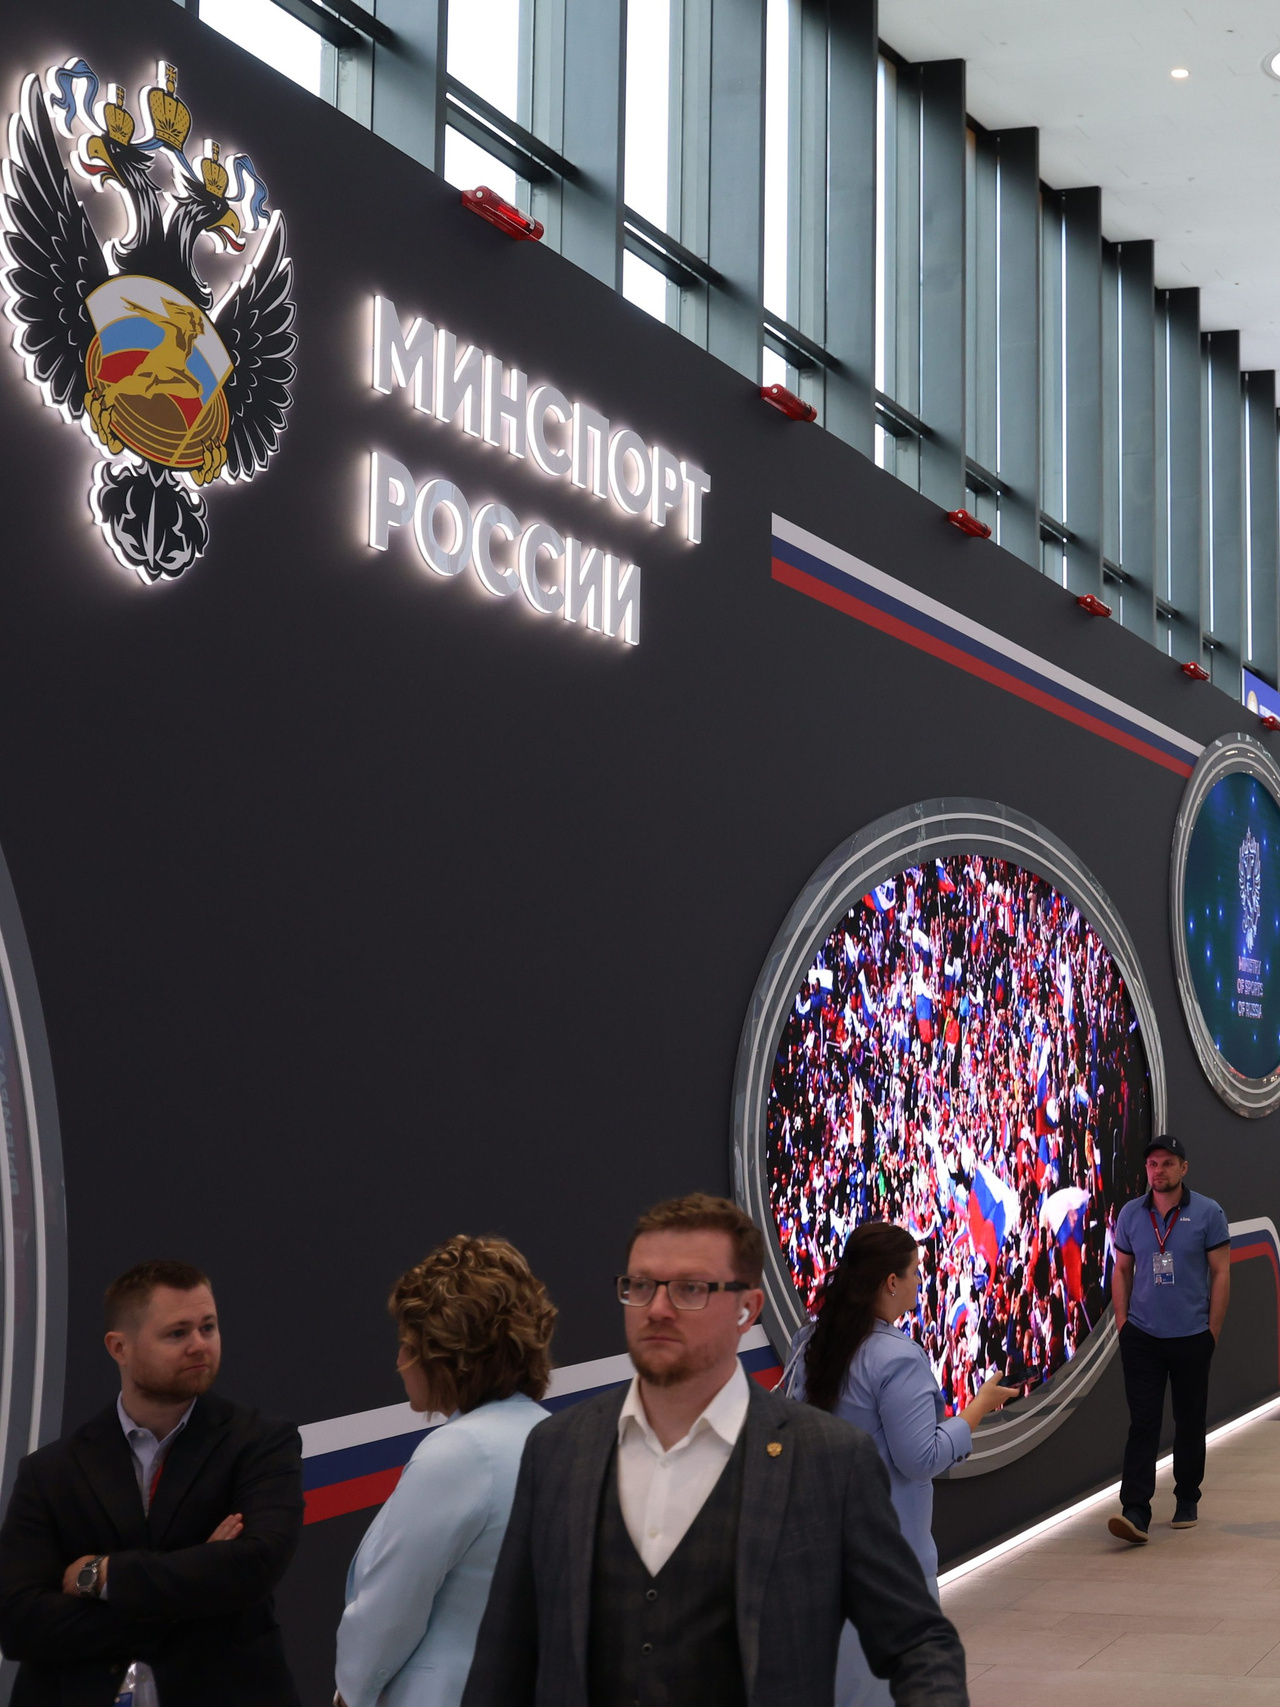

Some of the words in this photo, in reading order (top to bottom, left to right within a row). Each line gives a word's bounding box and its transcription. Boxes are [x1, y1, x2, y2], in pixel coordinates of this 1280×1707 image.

[371, 294, 711, 545] МИНСПОРТ
[368, 450, 642, 646] РОССИИ
[1238, 955, 1262, 975] MINISTRY
[1236, 978, 1245, 994] OF
[1244, 979, 1264, 997] SPORTS
[1237, 1000, 1245, 1017] OF
[1245, 1001, 1263, 1019] RUSSIA
